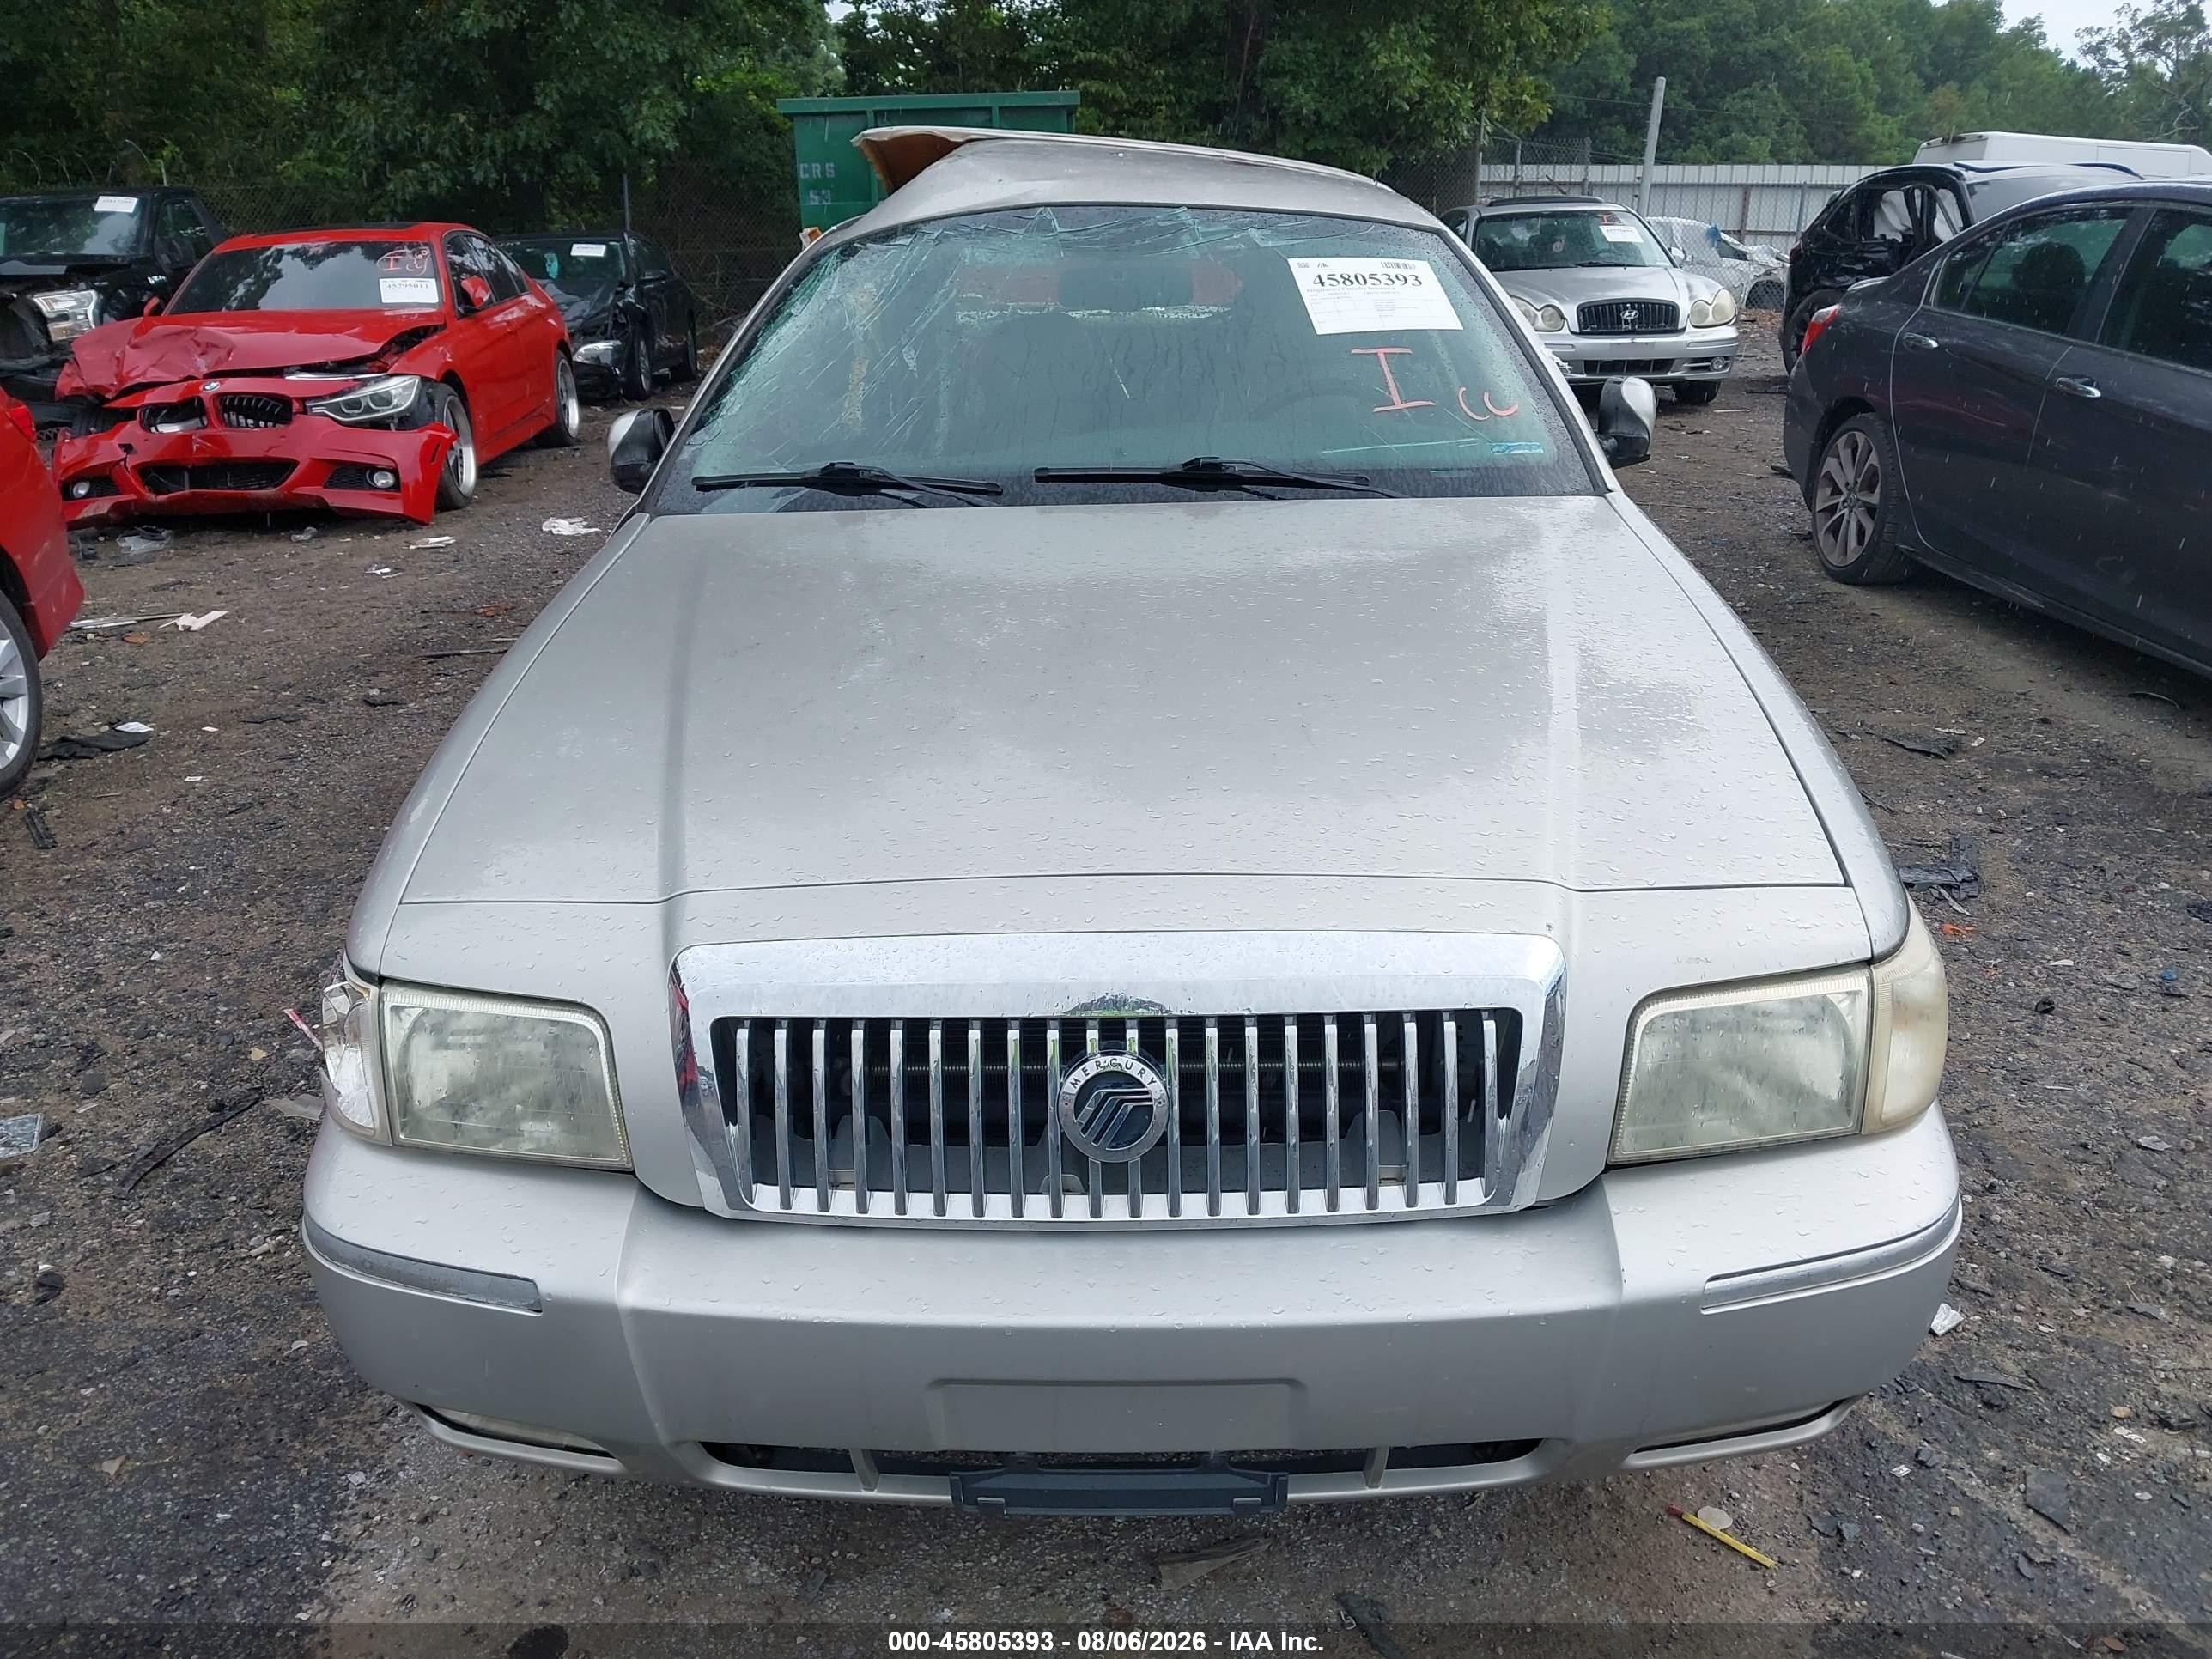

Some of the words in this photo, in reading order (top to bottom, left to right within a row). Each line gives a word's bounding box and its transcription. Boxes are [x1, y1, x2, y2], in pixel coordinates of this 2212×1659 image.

[799, 162, 835, 179] CRS
[1312, 272, 1424, 288] 45805393
[1070, 1058, 1157, 1090] MERCURY
